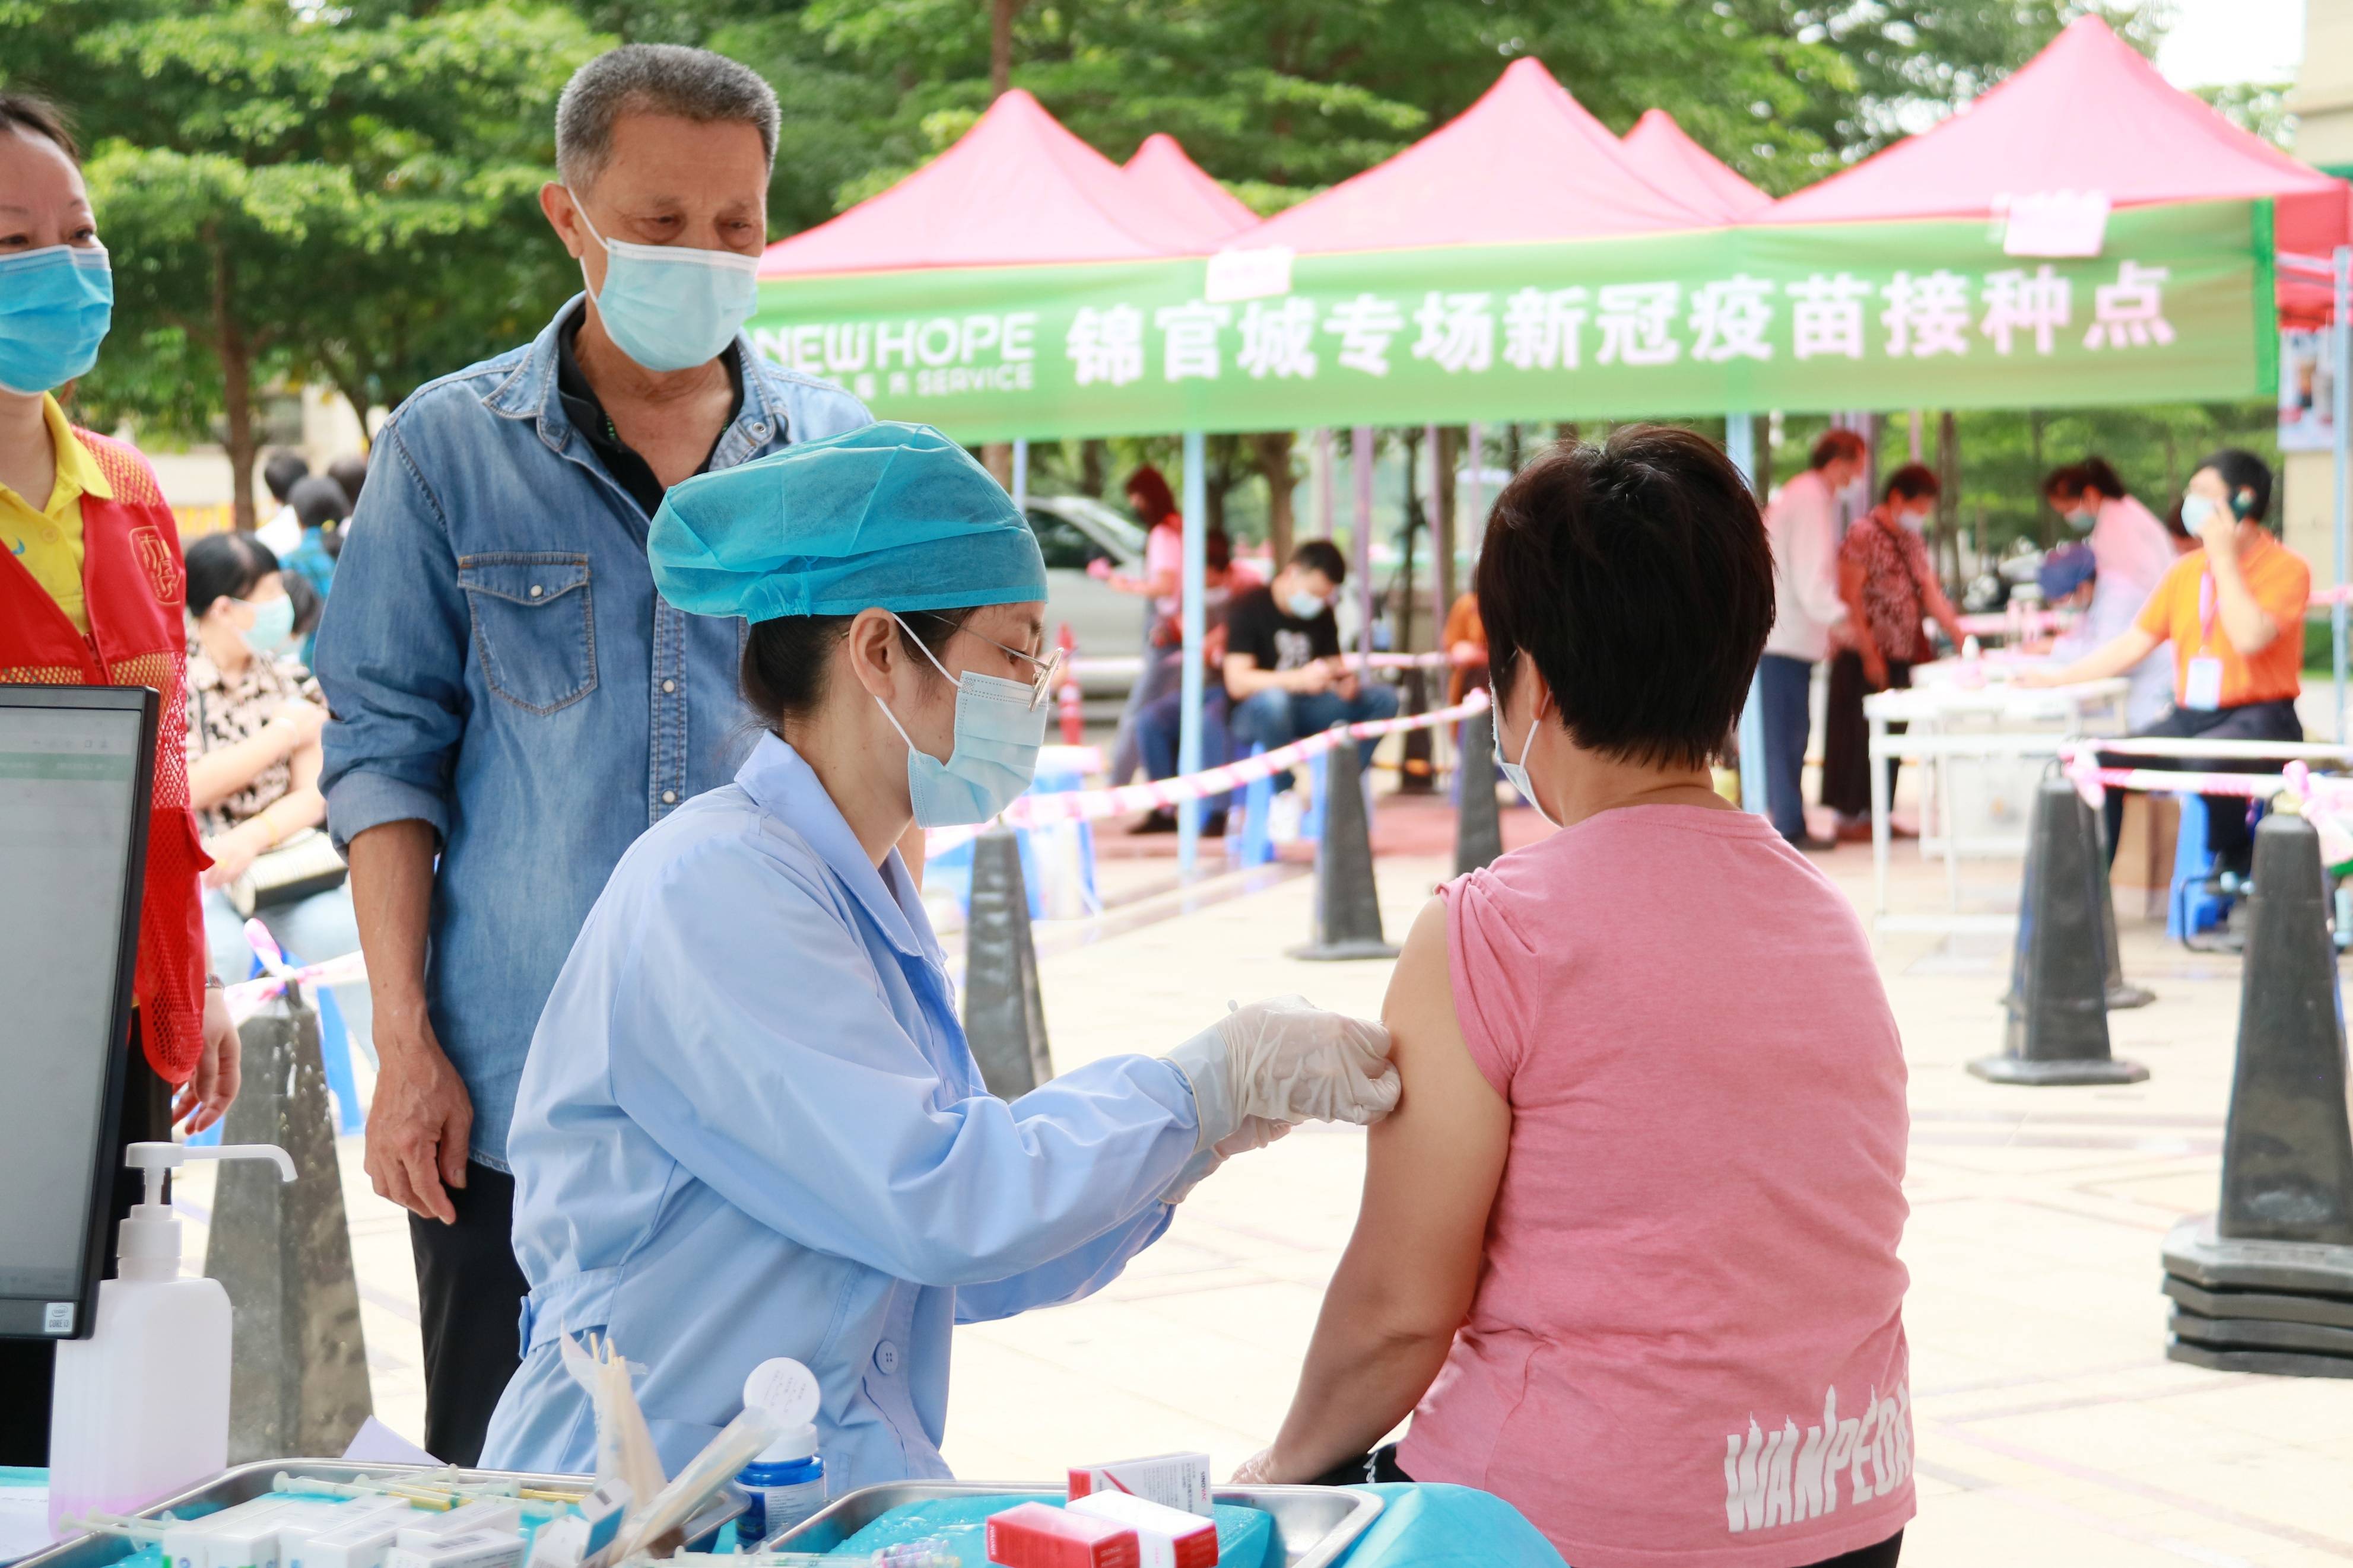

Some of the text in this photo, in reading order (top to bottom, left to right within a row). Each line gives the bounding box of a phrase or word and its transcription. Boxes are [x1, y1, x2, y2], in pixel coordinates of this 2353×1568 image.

[1066, 260, 2176, 385] 锦官城专场新冠疫苗接种点
[917, 362, 1033, 396] SERVICE
[49, 1319, 63, 1328] CORE
